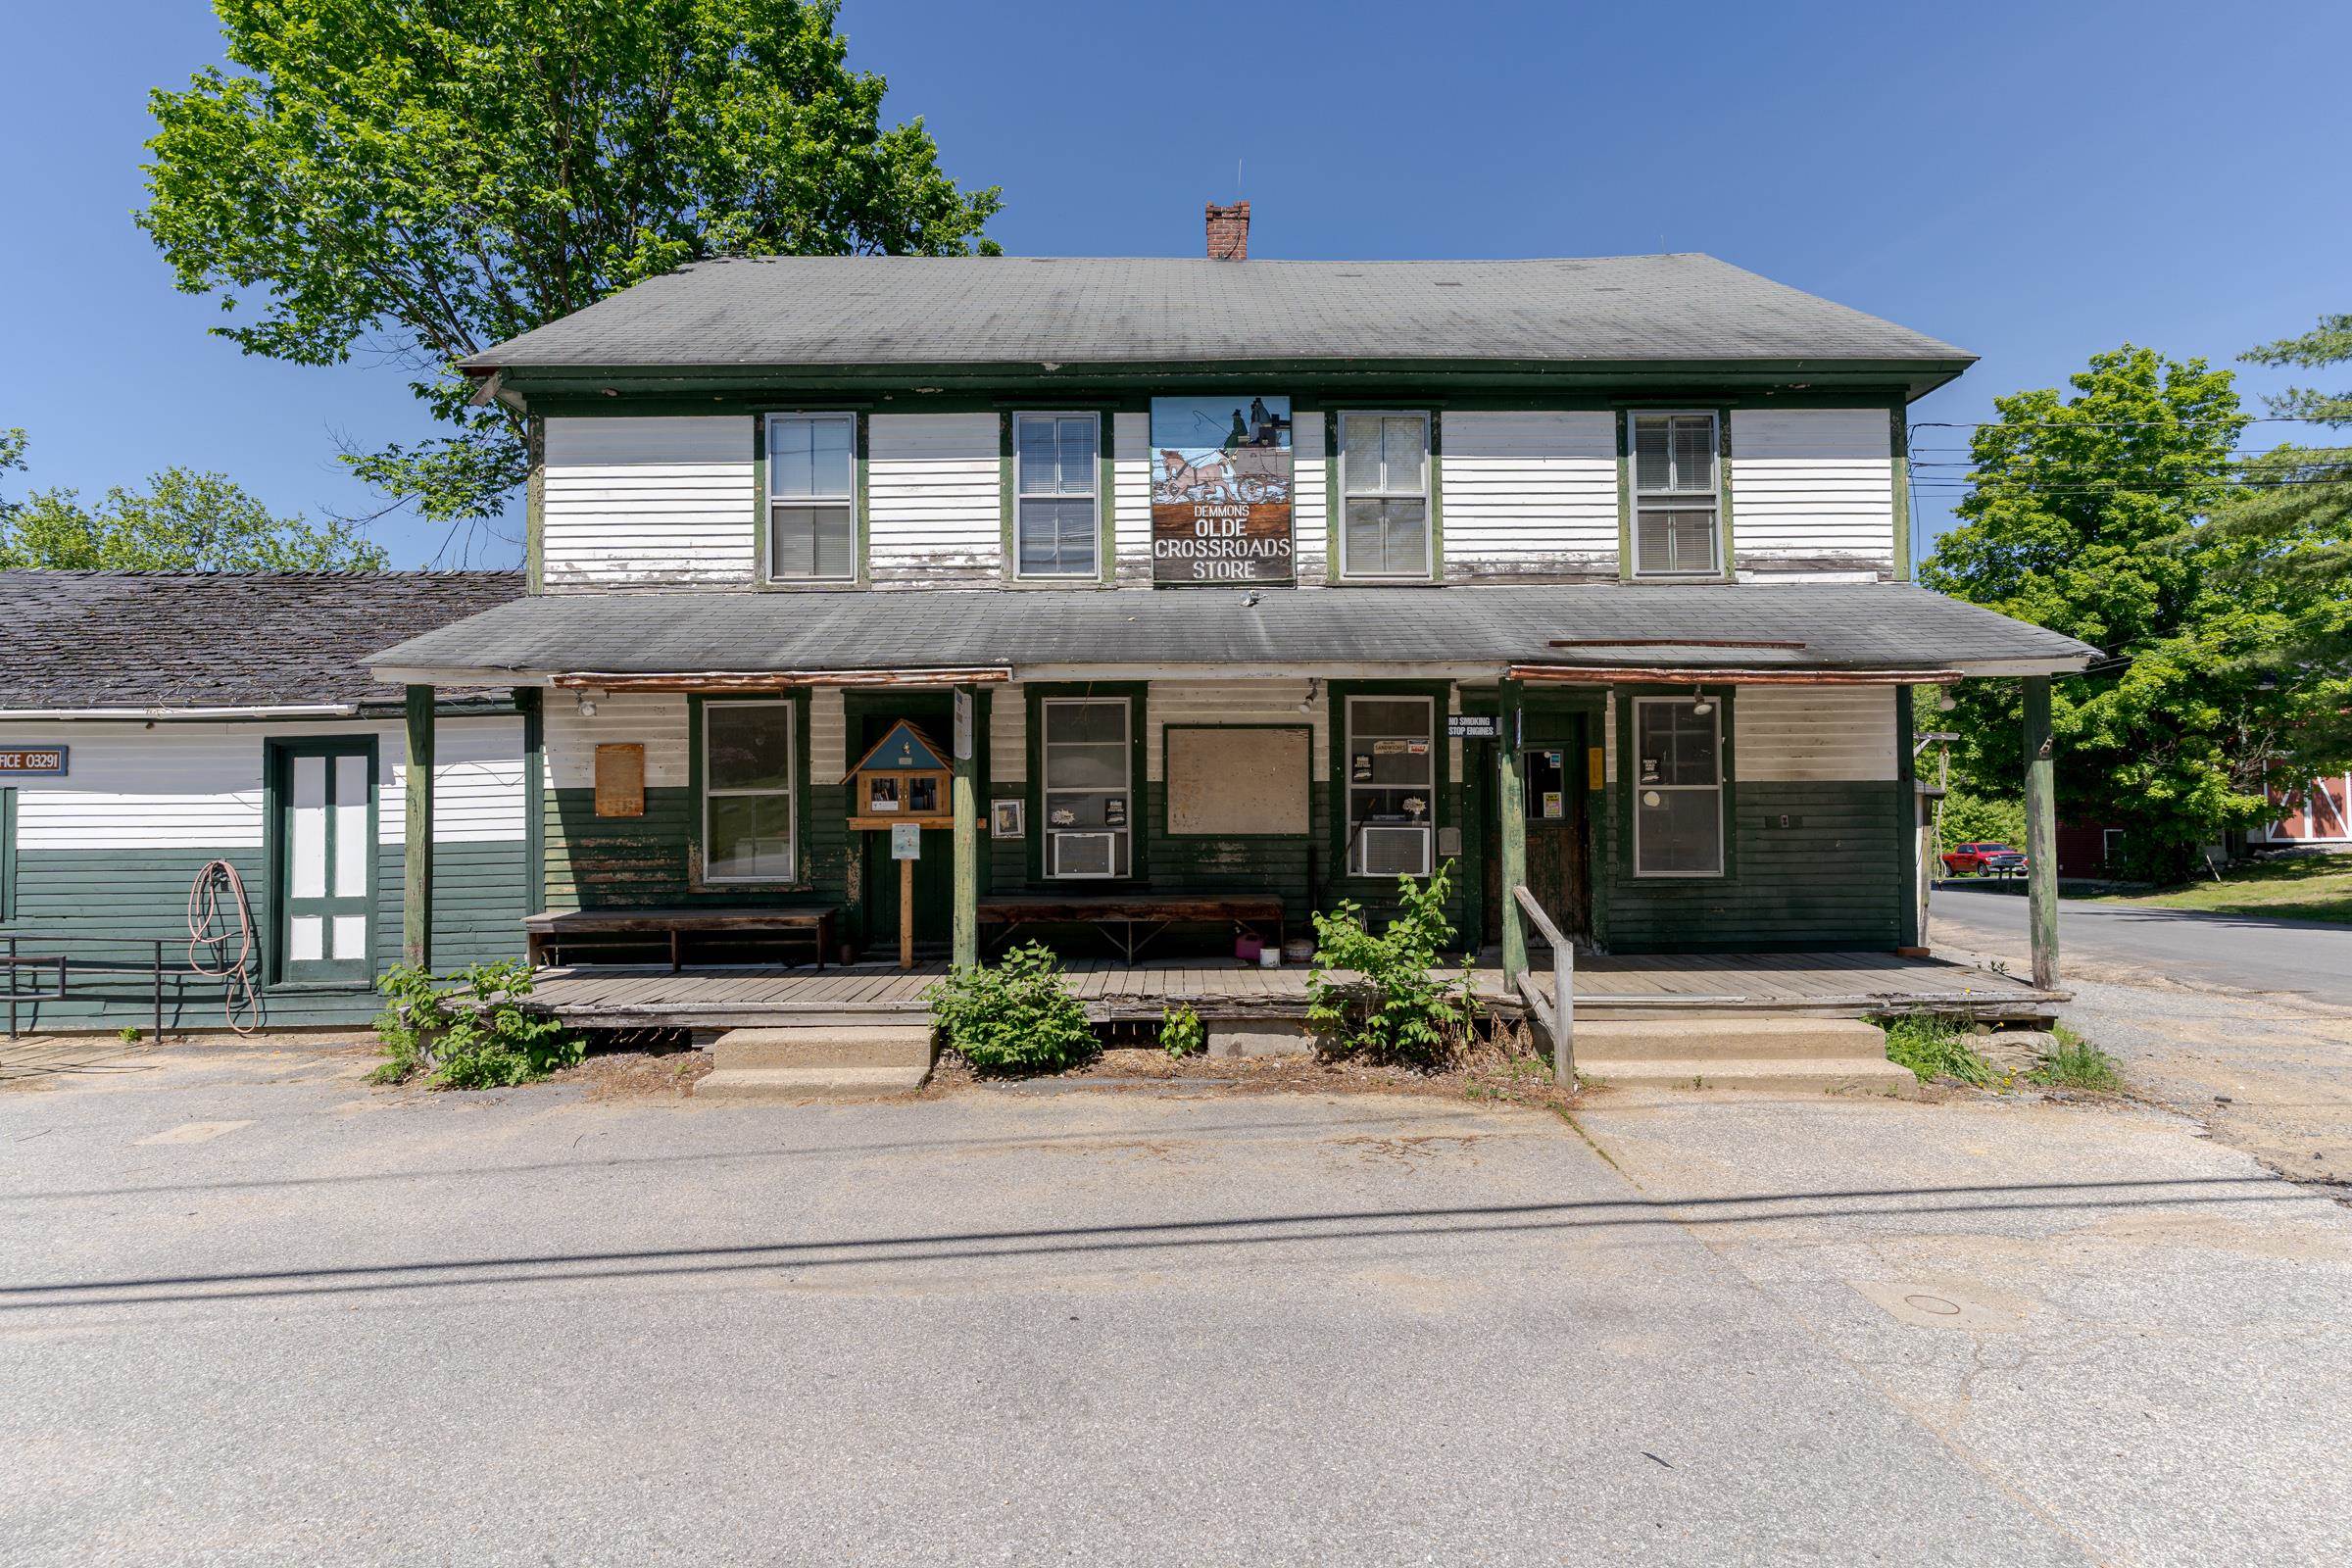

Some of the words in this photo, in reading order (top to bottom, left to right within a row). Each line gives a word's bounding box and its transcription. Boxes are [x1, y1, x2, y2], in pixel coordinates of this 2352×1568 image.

[1194, 505, 1250, 517] DEMMONS
[1195, 518, 1248, 537] OLDE
[1154, 538, 1291, 558] CROSSROADS
[1193, 561, 1255, 579] STORE
[26, 755, 58, 767] 03291
